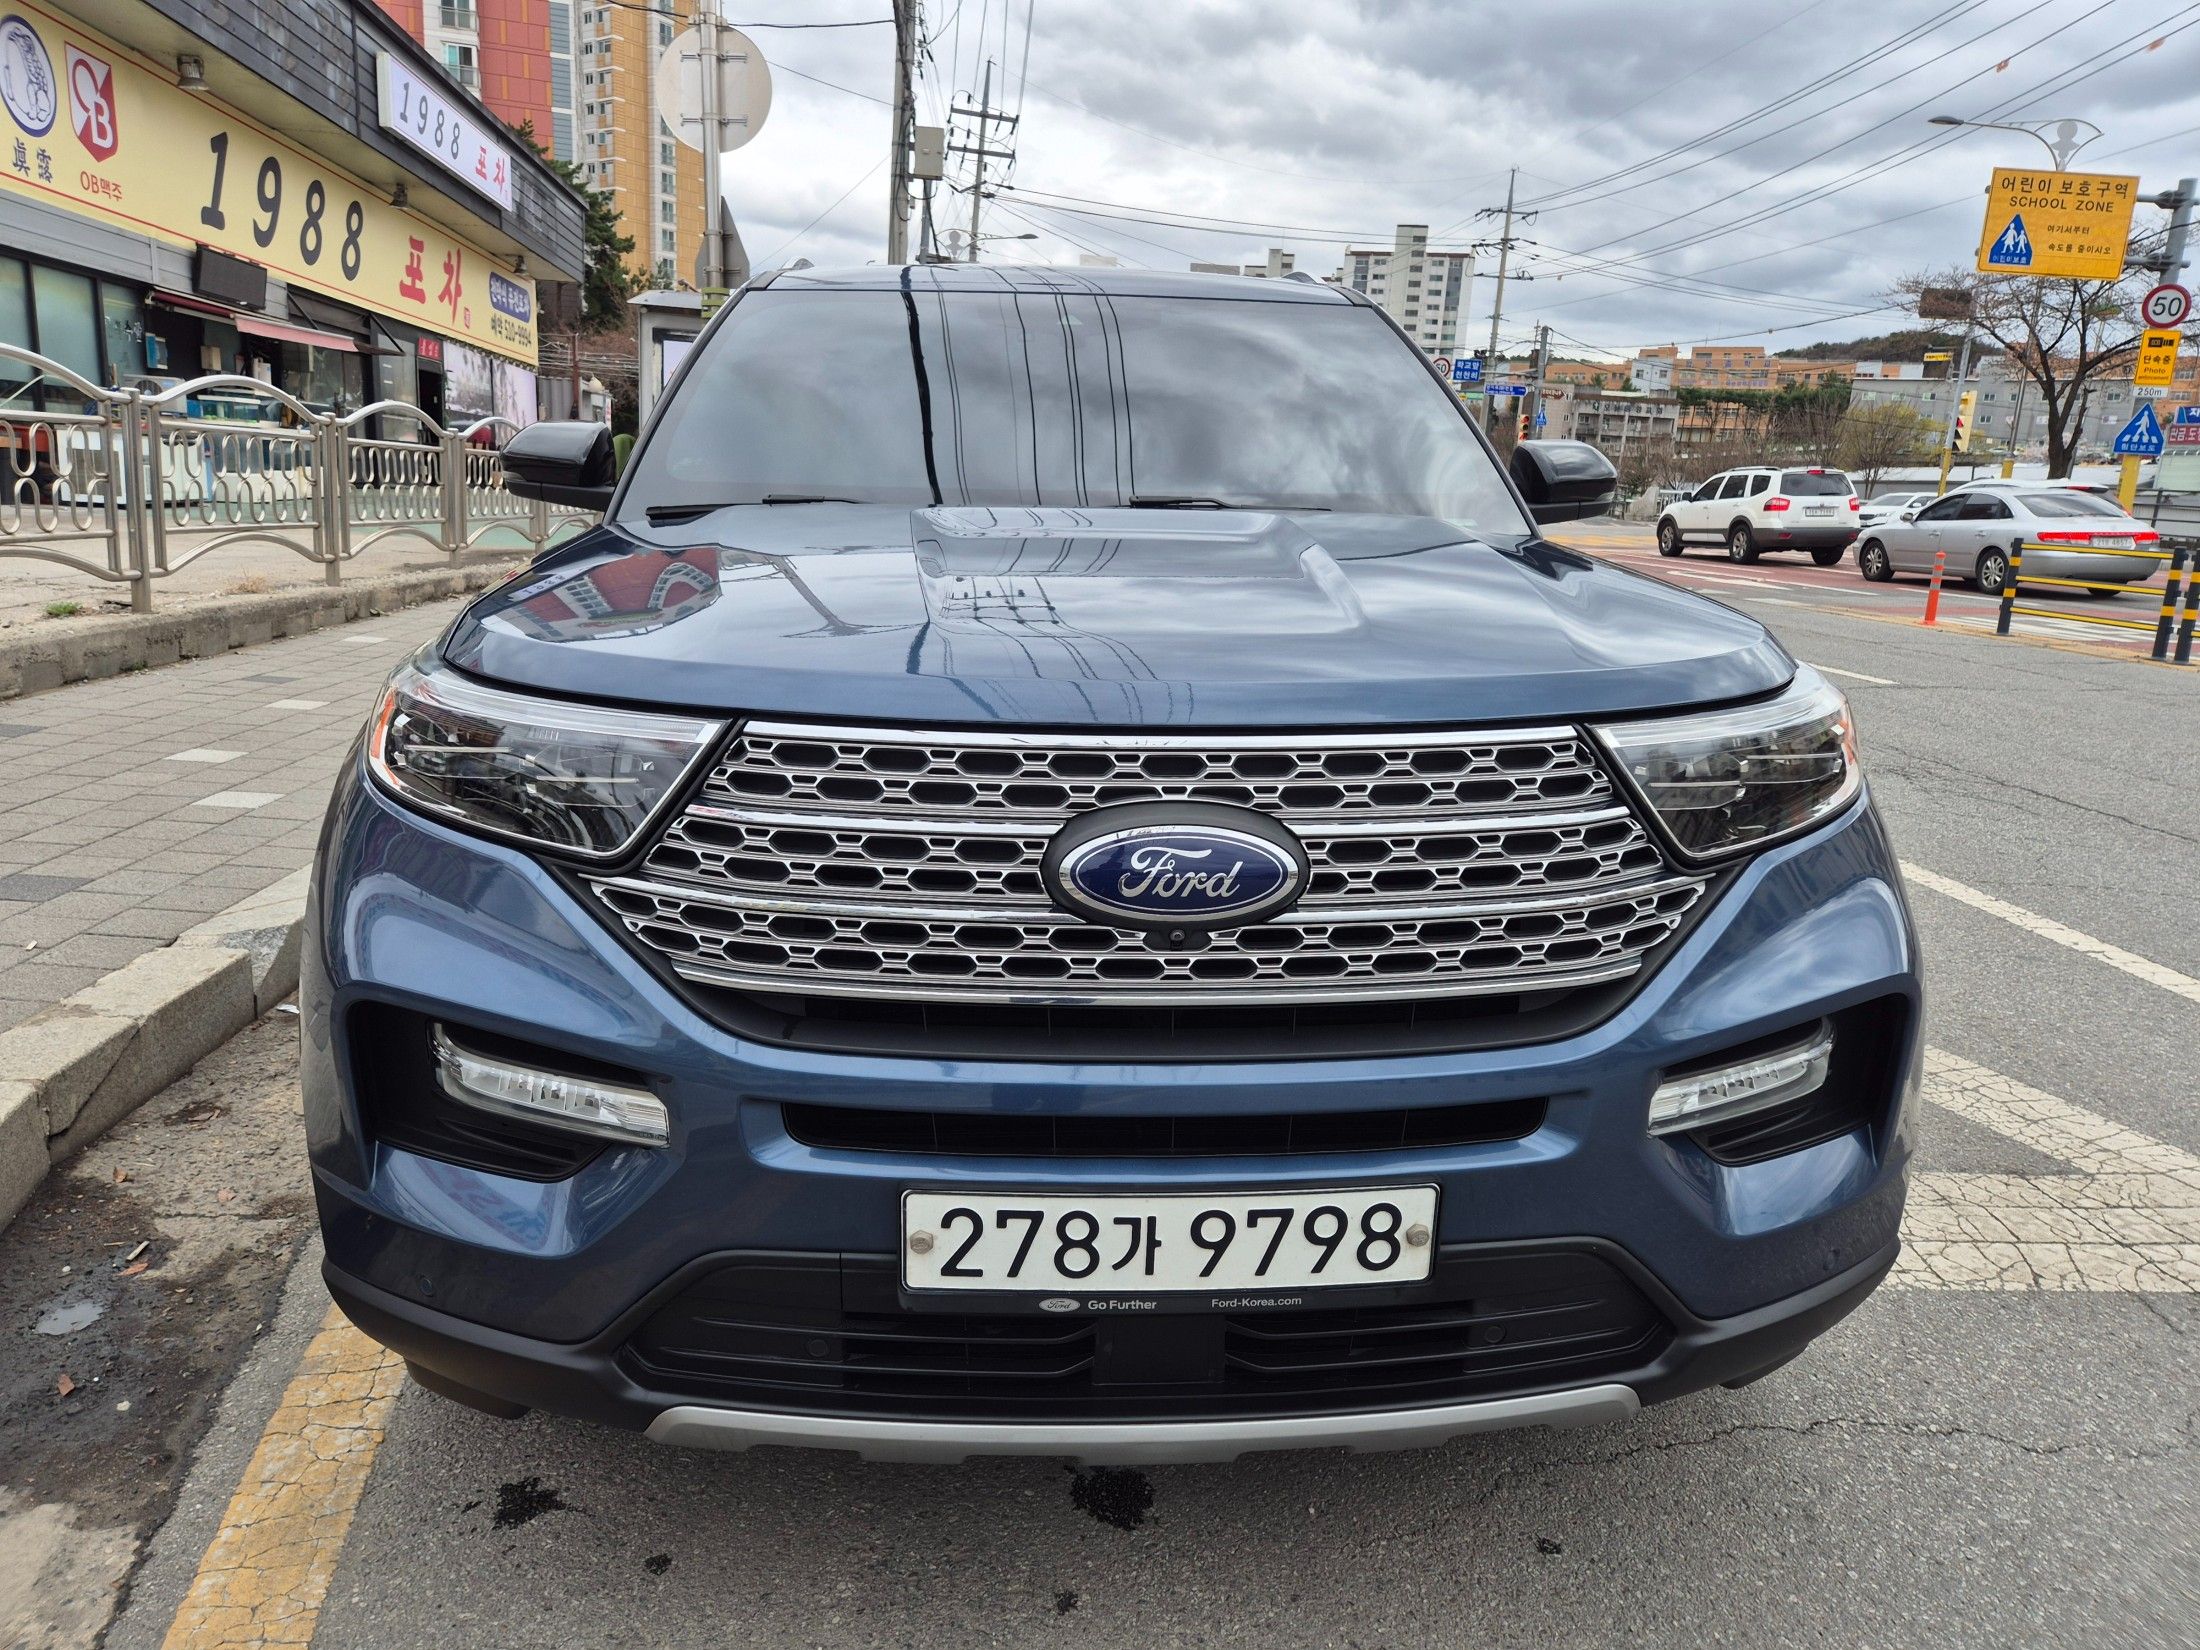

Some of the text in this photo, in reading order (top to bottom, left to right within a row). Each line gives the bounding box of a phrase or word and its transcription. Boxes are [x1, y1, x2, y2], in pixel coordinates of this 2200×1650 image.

[400, 82, 505, 192] 1988 포차
[80, 170, 123, 202] OB맥주
[2001, 177, 2129, 199] 어린이 보호구역
[2009, 196, 2114, 213] SCHOOL ZONE
[201, 131, 463, 324] 1988 포차
[2047, 224, 2091, 235] 여기서부터
[2048, 243, 2112, 255] 속도를 줄이시오
[2152, 296, 2182, 317] 50
[1456, 361, 1480, 370] 학교앞
[2143, 355, 2171, 365] 단속중
[1455, 371, 1479, 380] 천천히
[2143, 366, 2166, 375] Photo
[2137, 388, 2162, 396] 250m
[1118, 846, 1245, 898] Ford
[940, 1202, 1403, 1279] 278가 9798
[1047, 1297, 1302, 1310] Ford Go Further Ford-Korea.com
